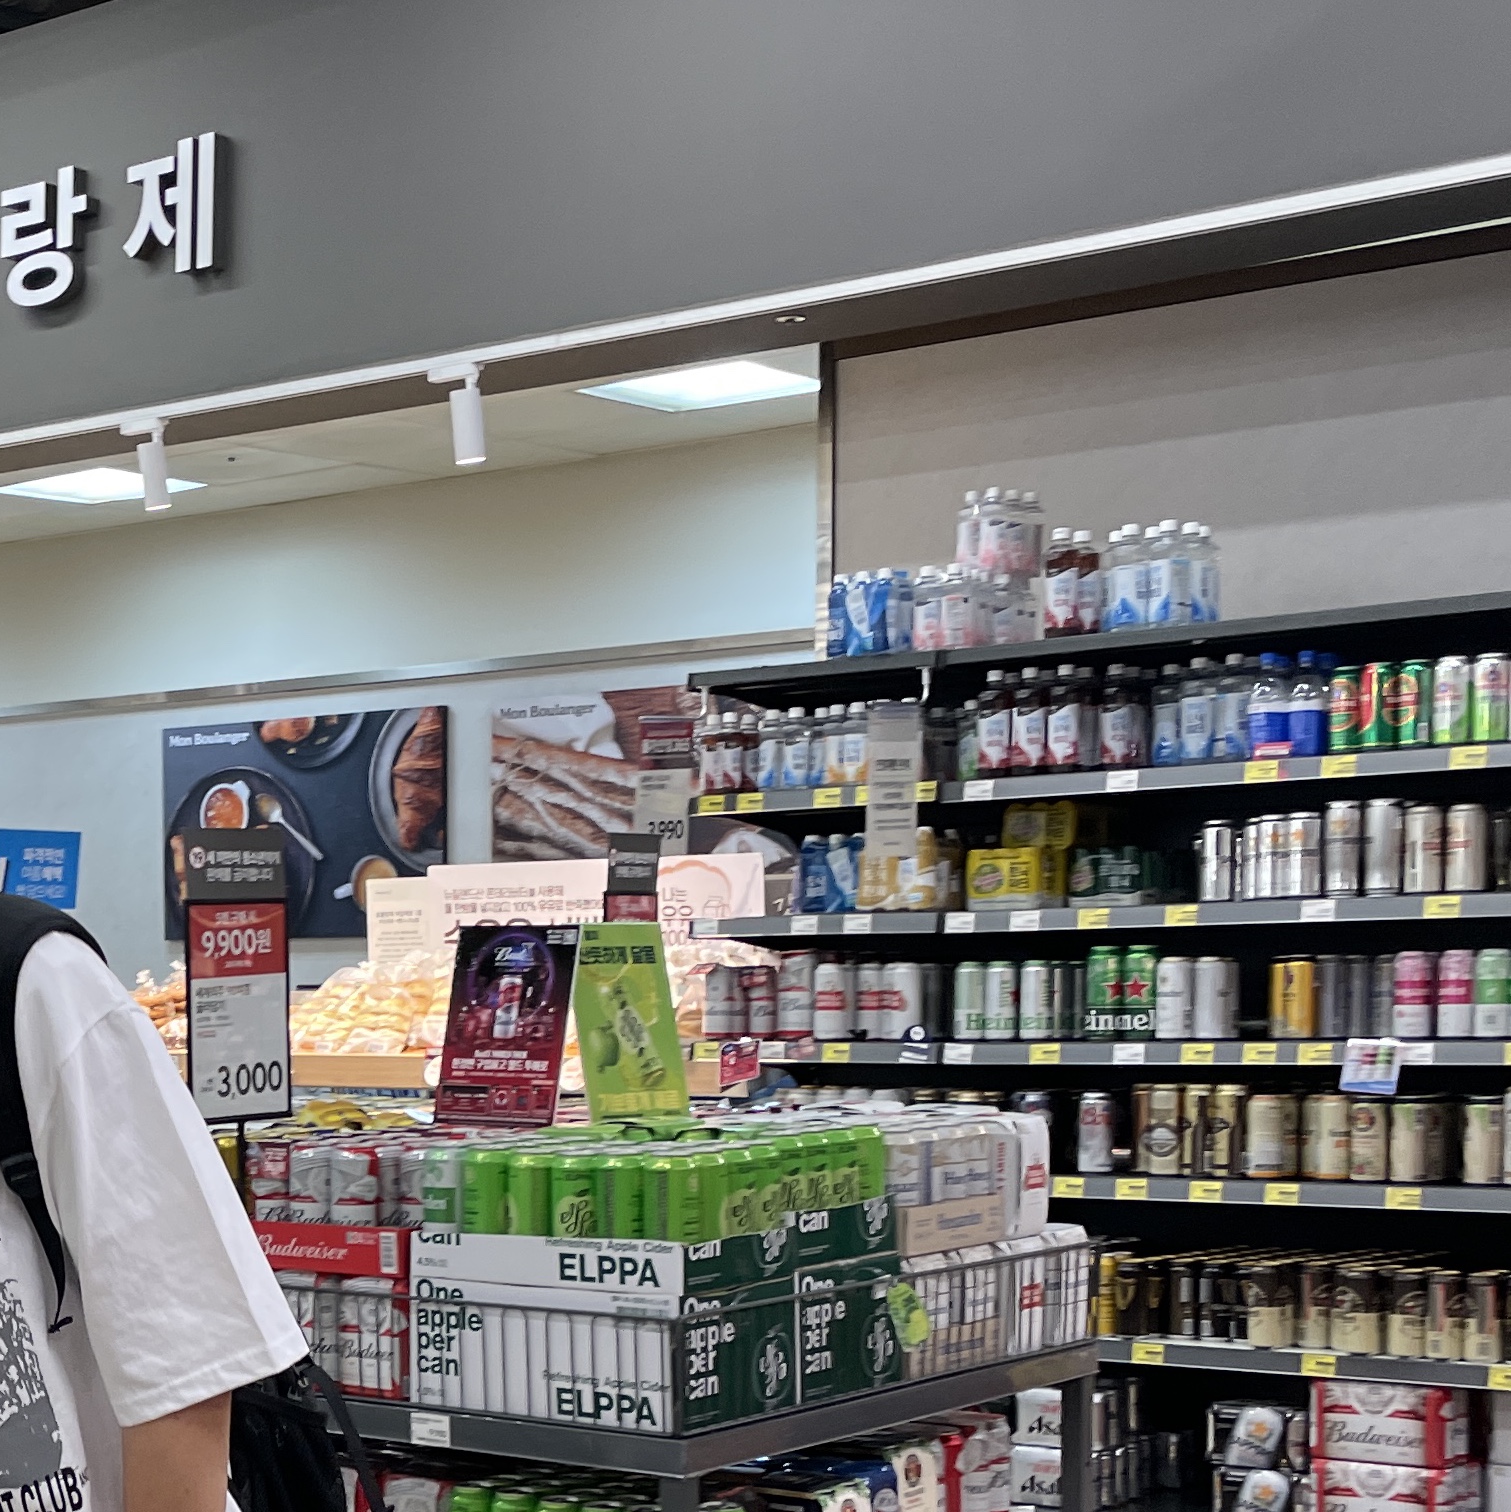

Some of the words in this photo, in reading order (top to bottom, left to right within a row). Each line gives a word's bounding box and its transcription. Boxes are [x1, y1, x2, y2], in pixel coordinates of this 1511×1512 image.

[169, 734, 191, 748] Mon
[194, 730, 250, 747] Boulanger
[201, 927, 272, 960] 9,900원
[217, 1061, 282, 1099] 3,000
[256, 1233, 350, 1261] Budweiser
[559, 1252, 660, 1289] ELPPA
[417, 1279, 464, 1300] One
[417, 1306, 483, 1334] apple
[417, 1331, 456, 1354] per
[417, 1353, 460, 1377] can
[556, 1386, 658, 1427] ELPPA
